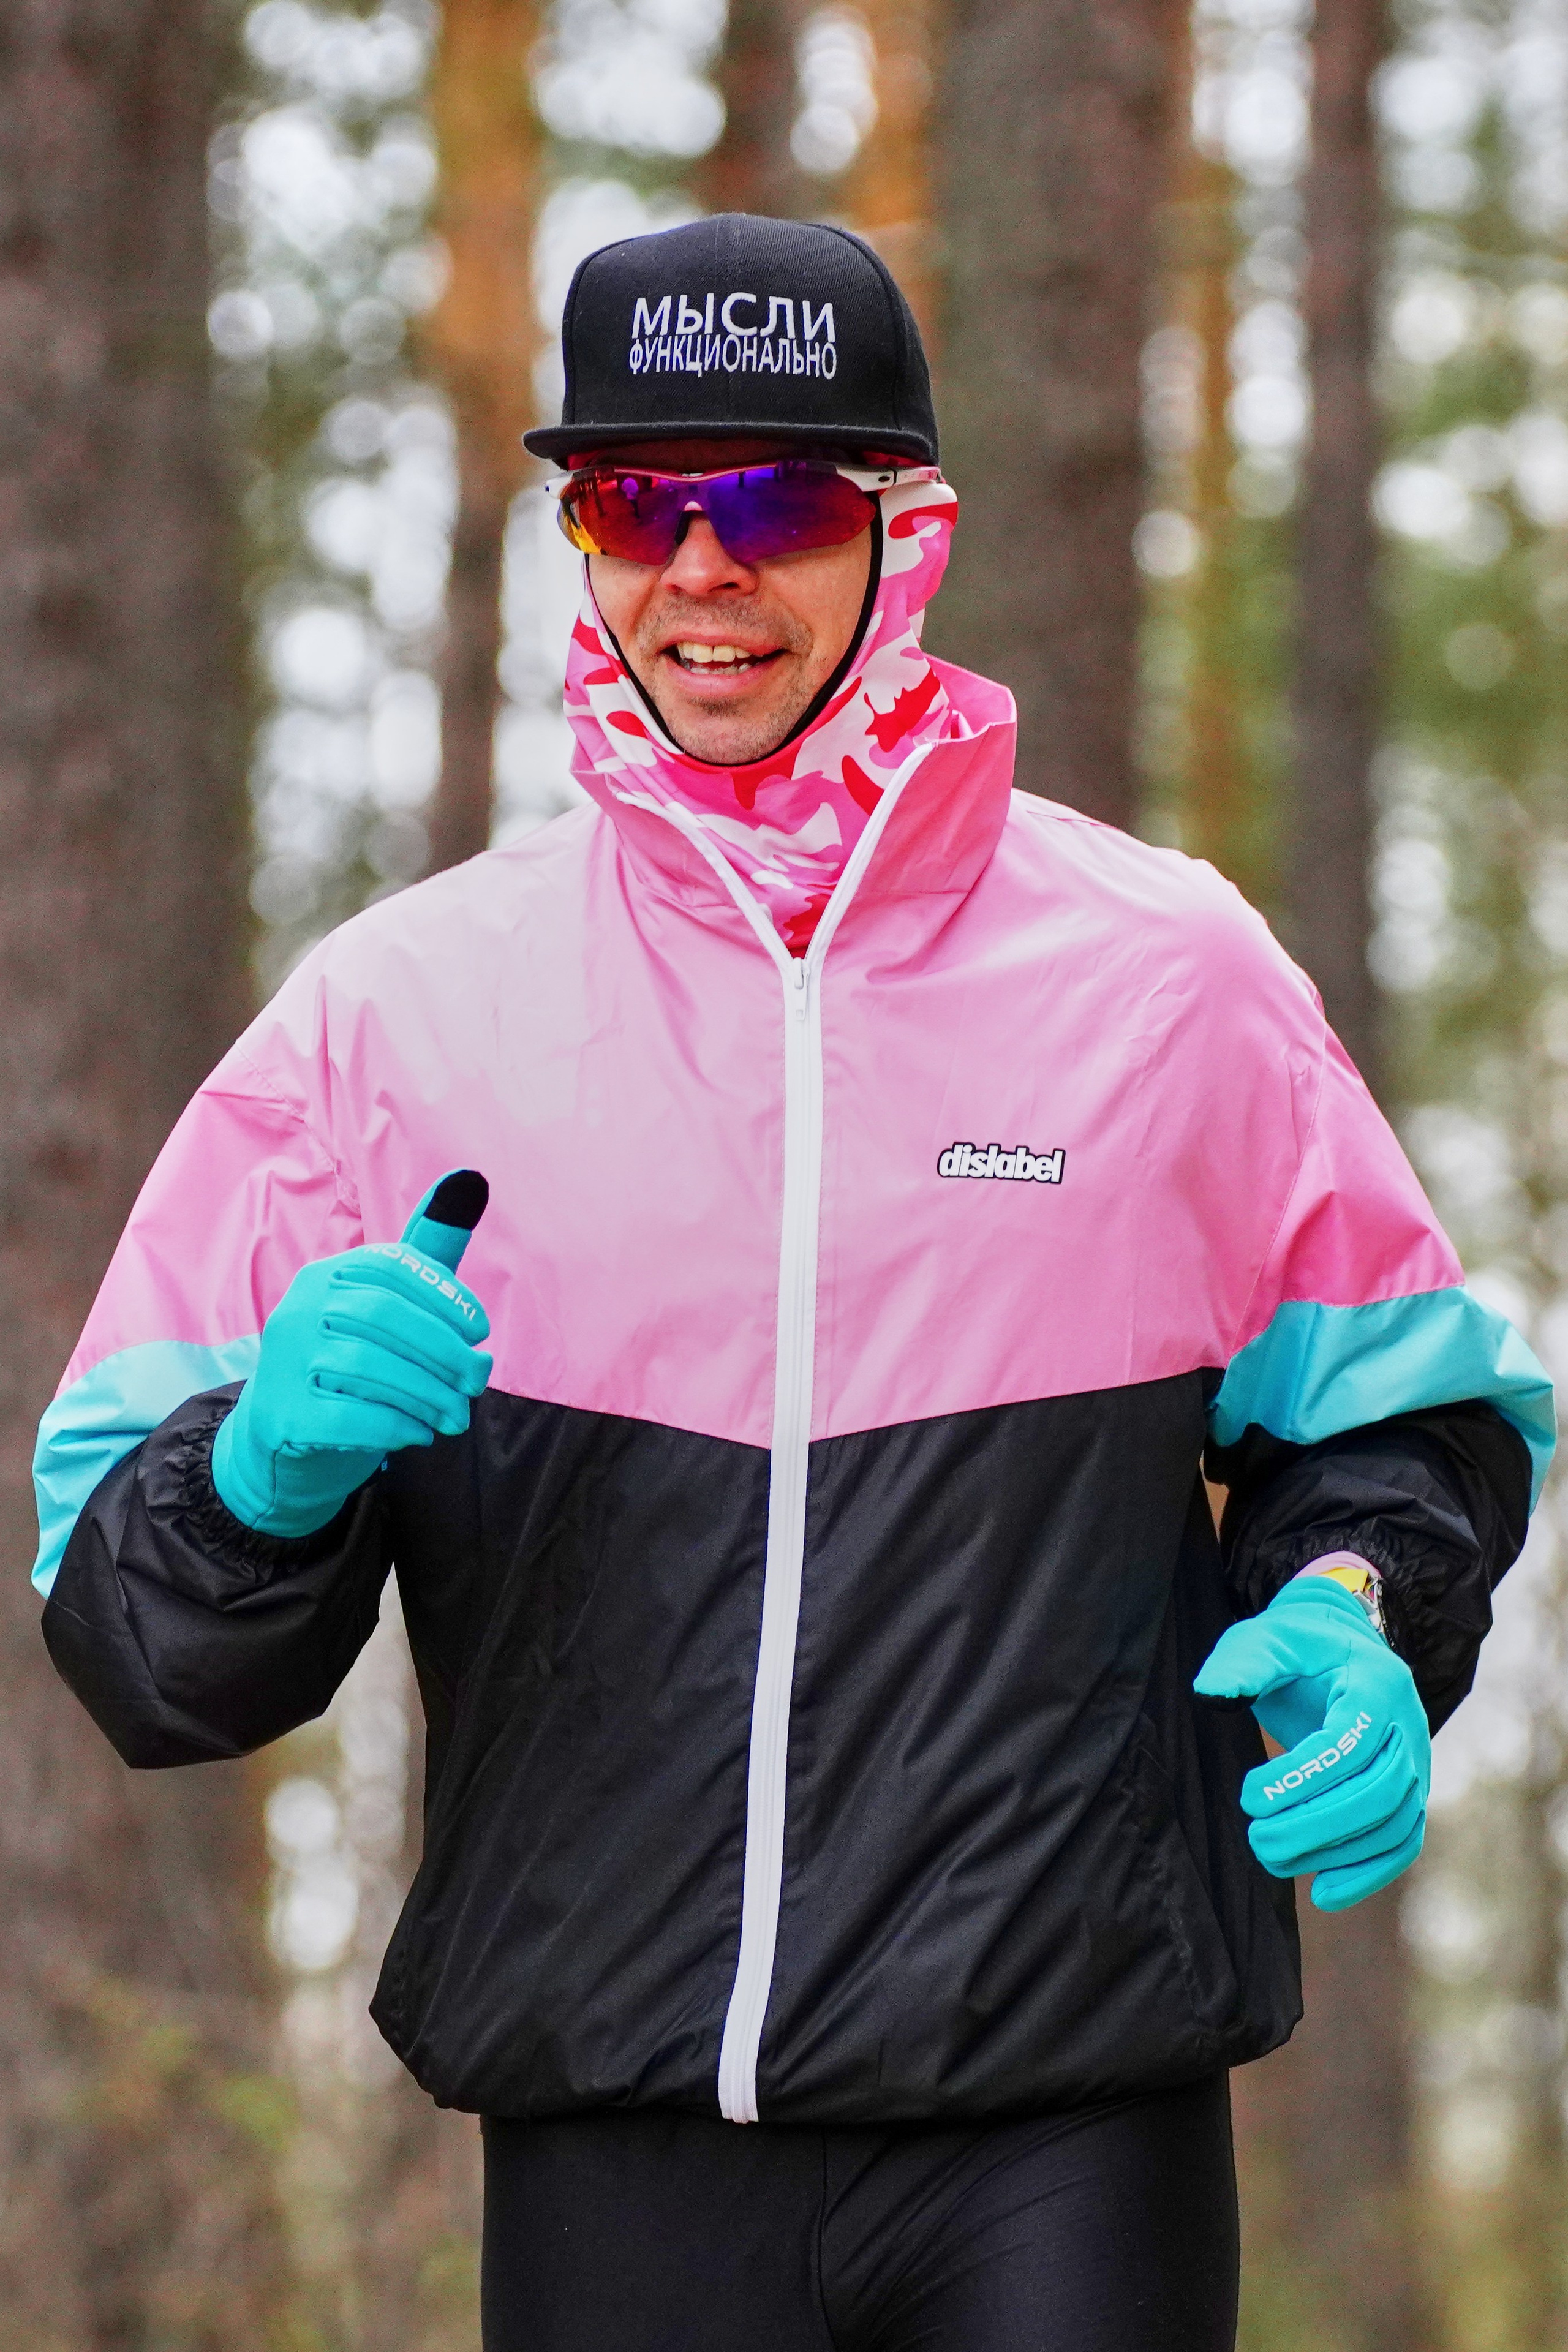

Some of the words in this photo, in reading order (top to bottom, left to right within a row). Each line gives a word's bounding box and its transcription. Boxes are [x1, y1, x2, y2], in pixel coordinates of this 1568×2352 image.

[631, 292, 835, 343] МЫСЛИ
[629, 334, 837, 380] ФУНКЦИОНАЛЬНО
[938, 1142, 1065, 1183] dislabel
[1262, 1711, 1372, 1800] NORDSKI
